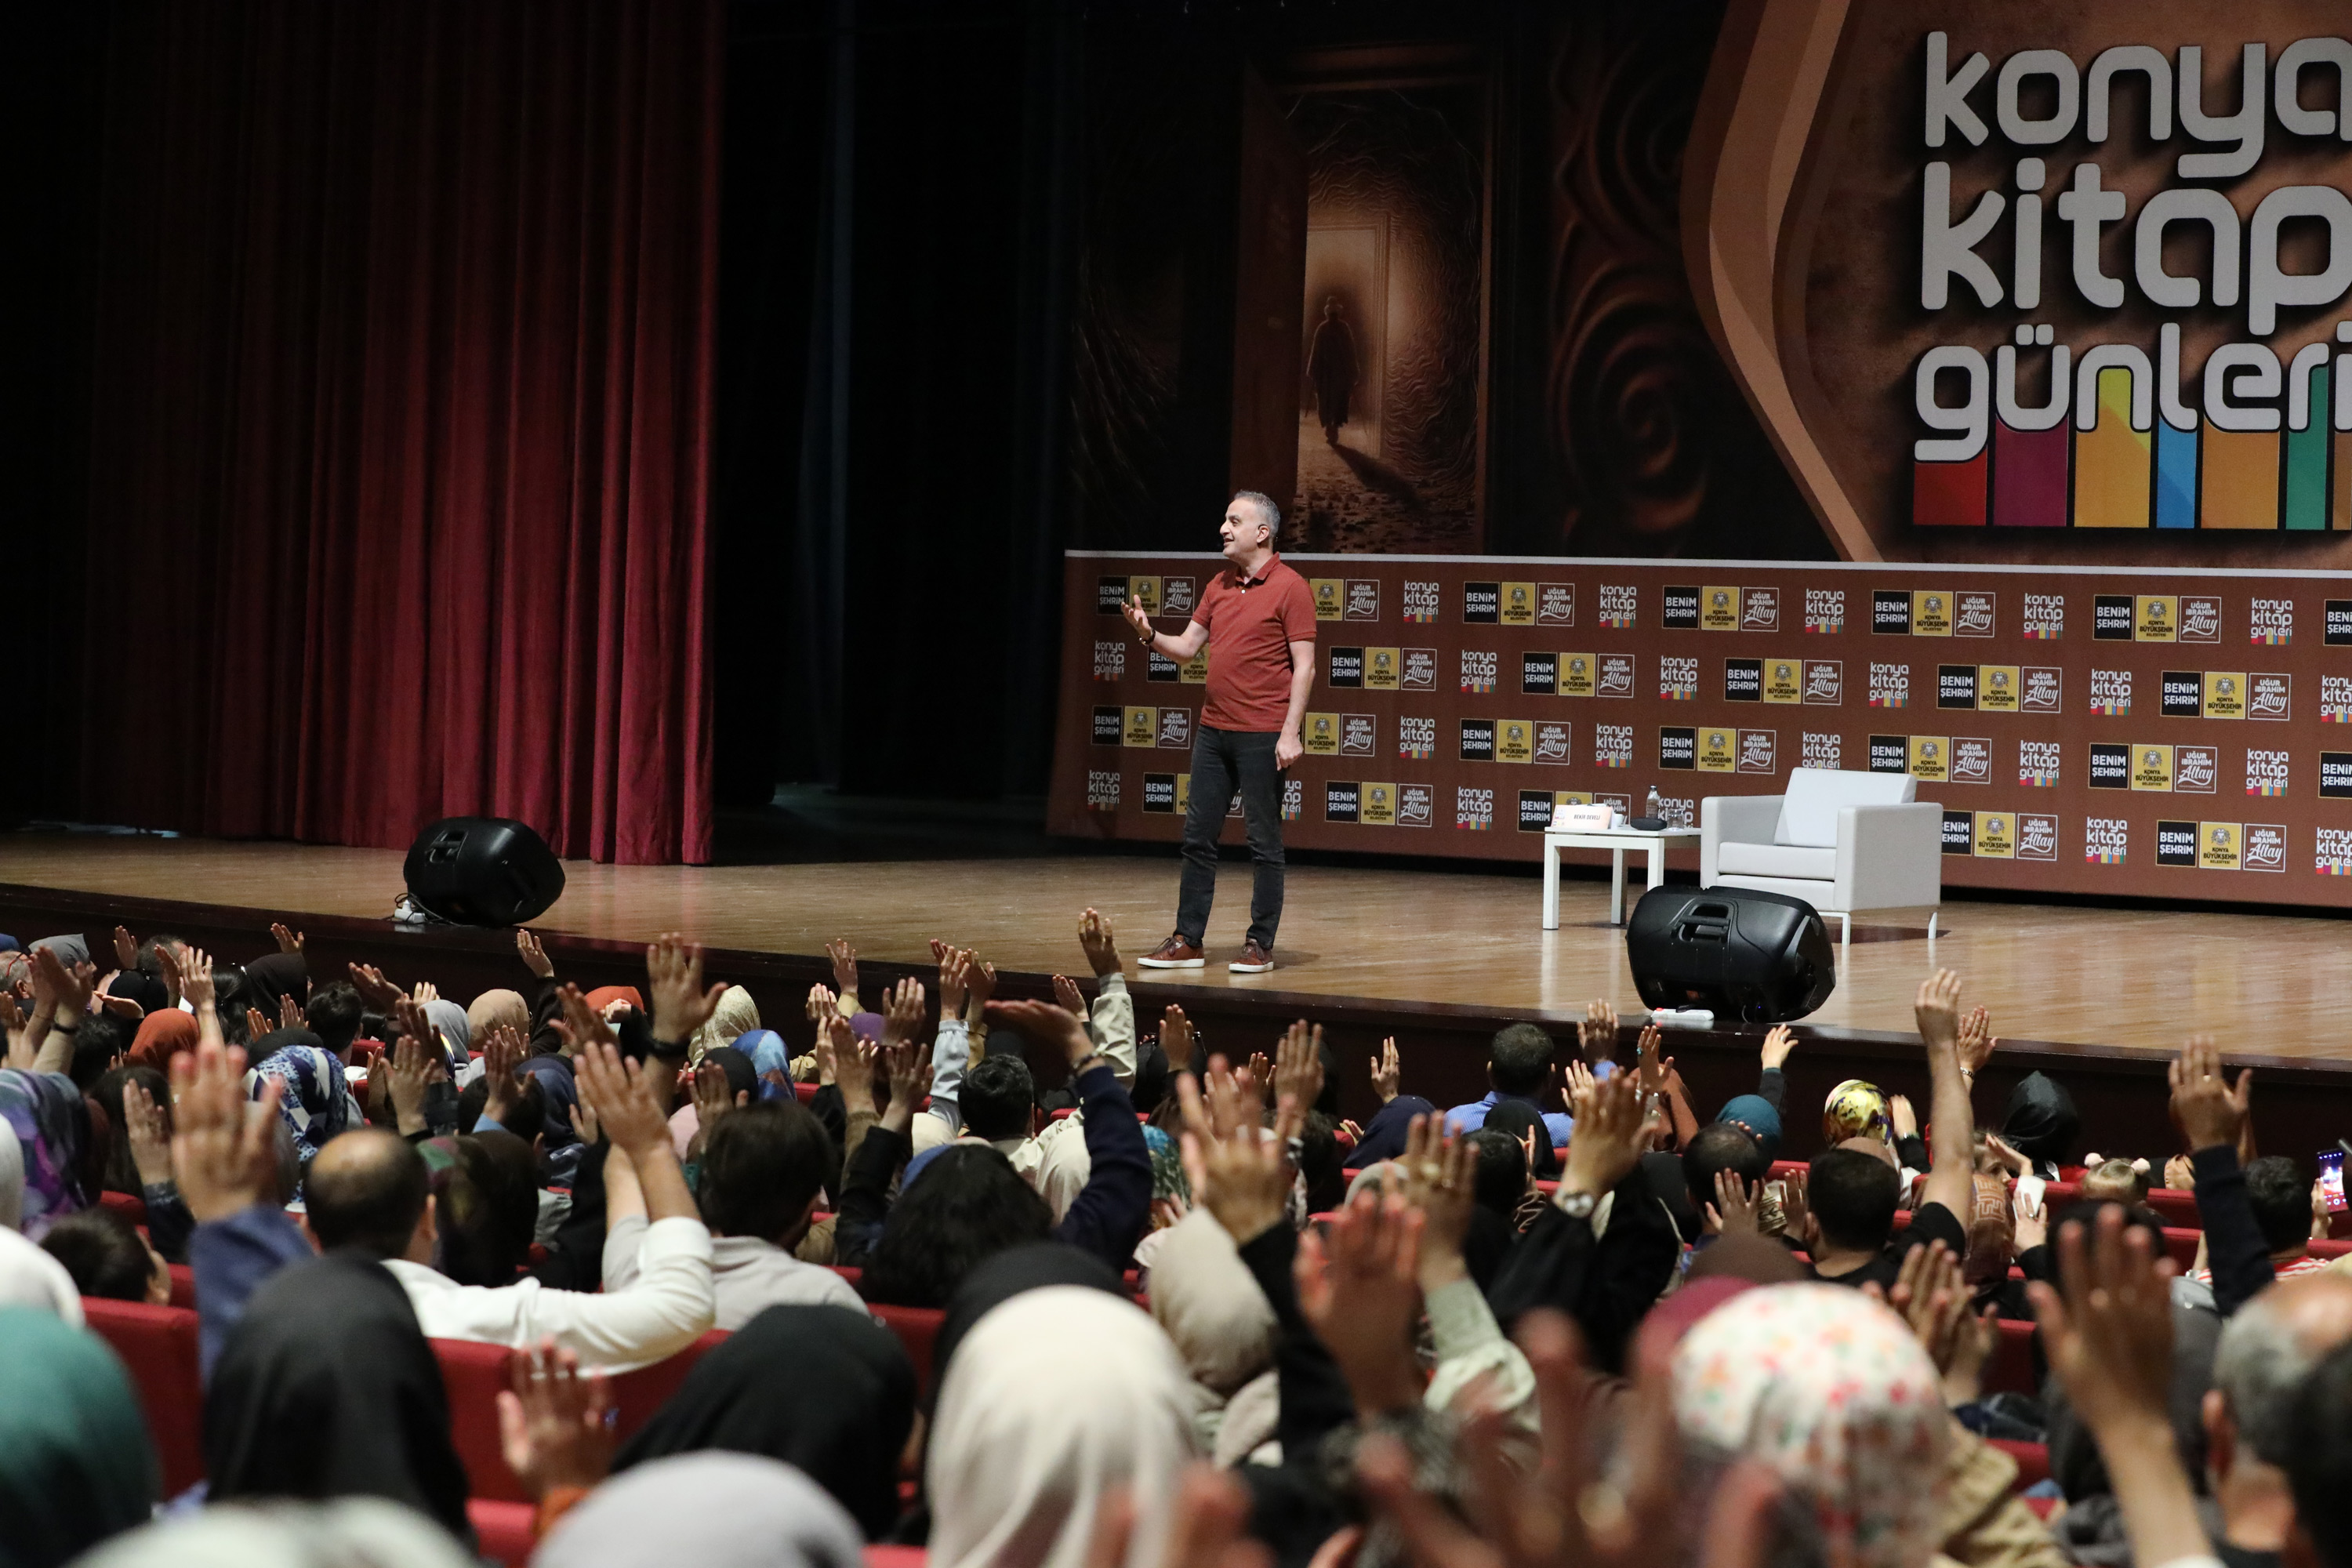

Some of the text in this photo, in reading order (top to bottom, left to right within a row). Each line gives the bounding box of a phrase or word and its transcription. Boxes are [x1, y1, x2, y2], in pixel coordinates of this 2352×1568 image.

[1926, 31, 2352, 178] konya
[1922, 158, 2352, 336] kitap
[1915, 321, 2352, 461] günleri
[1600, 584, 1636, 597] konya
[1806, 589, 1844, 601] konya
[1599, 595, 1636, 612] kitap
[2025, 593, 2063, 606] konya
[2252, 597, 2292, 611] konya
[1806, 600, 1844, 617] kitap
[2024, 605, 2063, 622] kitap
[1599, 610, 1635, 621] günleri
[1805, 615, 1843, 626] günleri
[2251, 610, 2292, 628] kitap
[2024, 620, 2063, 632] günleri
[2251, 626, 2292, 637] günleri
[2328, 624, 2352, 634] ŞEHR
[1462, 650, 1496, 662] konya
[1661, 655, 1697, 668] konya
[1461, 661, 1496, 677] kitap
[1871, 662, 1908, 675] konya
[1461, 675, 1495, 686] günleri
[1661, 667, 1697, 684] kitap
[1870, 673, 1908, 691] kitap
[2092, 669, 2131, 682] konya
[1660, 681, 1697, 693] günleri
[2322, 675, 2352, 691] kony
[1869, 688, 1907, 700] günleri
[2091, 681, 2131, 699] kitap
[2321, 688, 2352, 702] kita
[2090, 696, 2130, 708] günleri
[2321, 702, 2352, 716] günle
[1597, 724, 1632, 736] konya
[1596, 735, 1632, 752] kitap
[1803, 731, 1840, 745] konya
[1802, 743, 1840, 760] kitap
[2020, 740, 2060, 753] konya
[1595, 749, 1632, 760] günleri
[2020, 752, 2060, 770] kitap
[2248, 749, 2288, 762] konya
[1802, 758, 1840, 768] günleri
[2247, 760, 2288, 779] kitap
[2020, 768, 2059, 779] günleri
[2246, 776, 2288, 789] günleri
[1458, 786, 1492, 800] konya
[1457, 797, 1492, 815] kitap
[1457, 811, 1491, 823] günleri
[2087, 817, 2127, 830] konya
[2086, 829, 2126, 847] kitap
[2317, 827, 2352, 844] kony
[2086, 844, 2126, 856] günleri
[2315, 855, 2352, 868] günle
